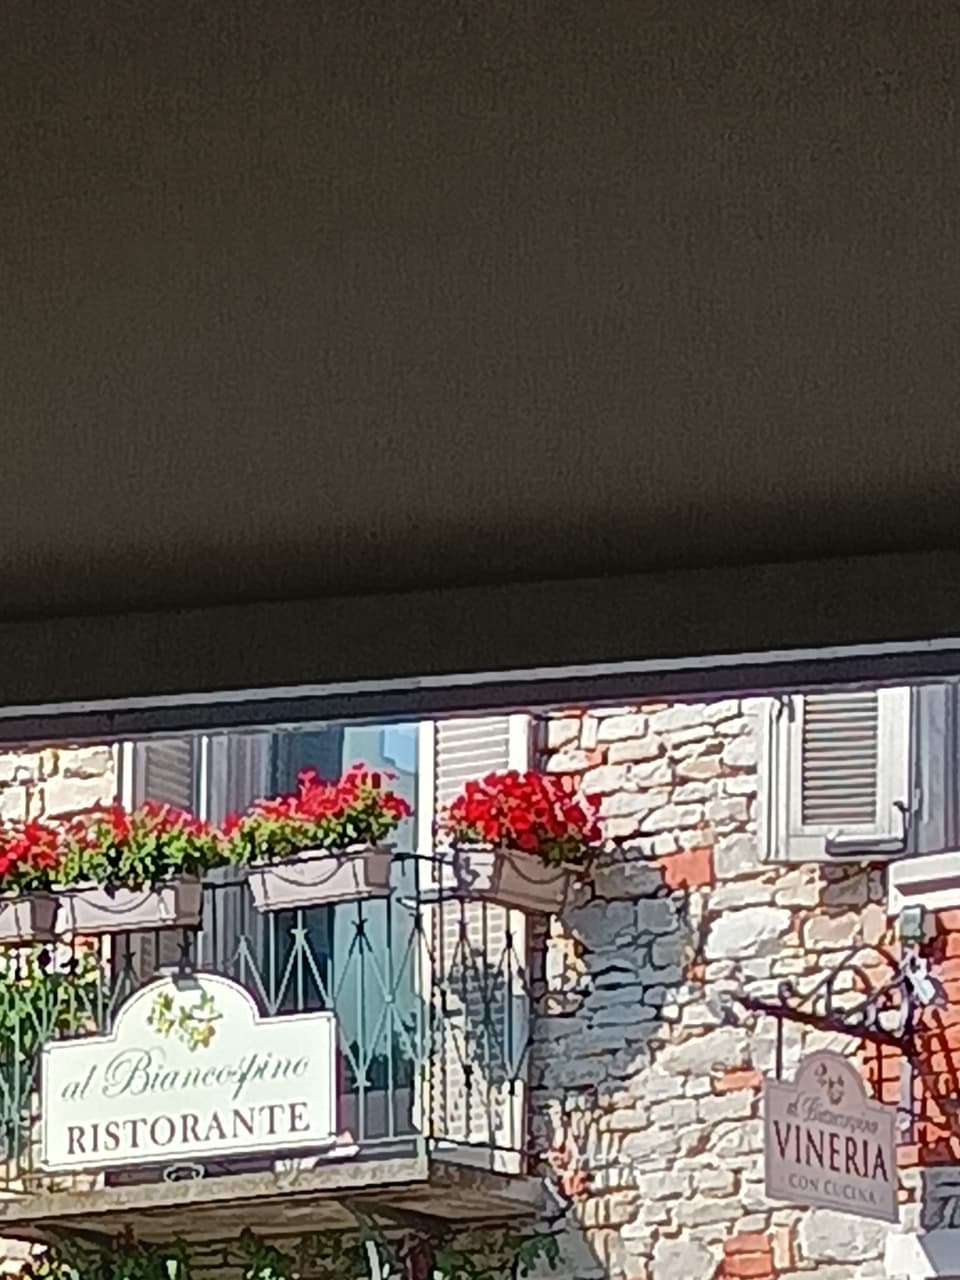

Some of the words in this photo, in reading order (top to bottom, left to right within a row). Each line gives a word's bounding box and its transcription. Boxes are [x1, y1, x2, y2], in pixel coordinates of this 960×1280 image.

[61, 1063, 98, 1102] al
[102, 1046, 310, 1101] Biancospino
[67, 1102, 311, 1155] RISTORANTE
[773, 1119, 889, 1183] VINERIA
[788, 1172, 820, 1192] CON
[823, 1178, 877, 1205] CUCINA
